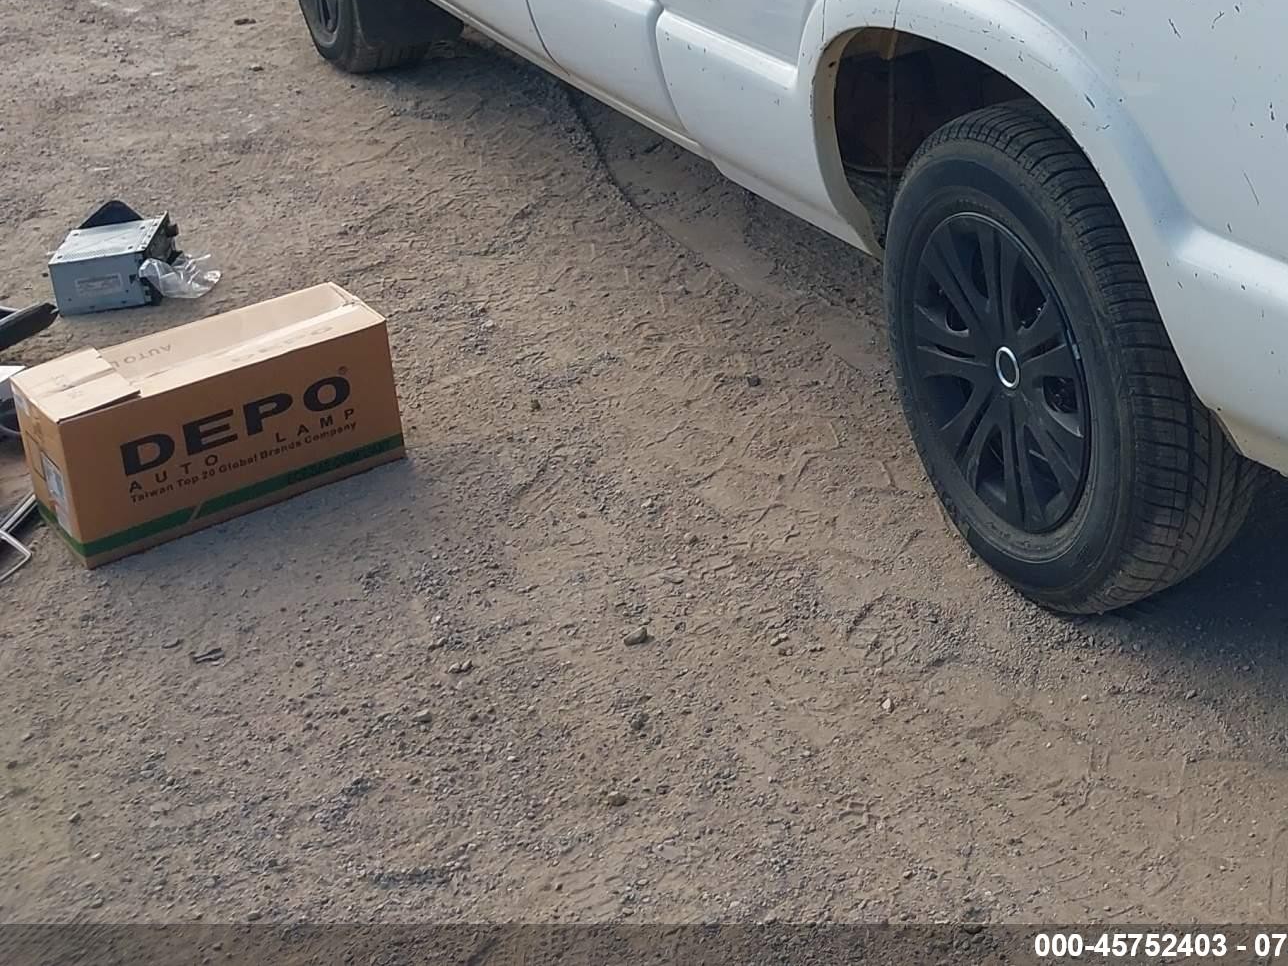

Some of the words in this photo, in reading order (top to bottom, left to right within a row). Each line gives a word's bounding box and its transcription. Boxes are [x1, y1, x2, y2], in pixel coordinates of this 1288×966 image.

[120, 376, 351, 475] DEPO
[129, 454, 219, 494] AUTO
[275, 408, 355, 443] LAMP
[130, 483, 174, 503] Taiwan
[176, 474, 200, 488] Top
[201, 468, 216, 480] 20
[218, 453, 258, 474] Global
[260, 441, 302, 460] Brands
[304, 421, 357, 444] Company
